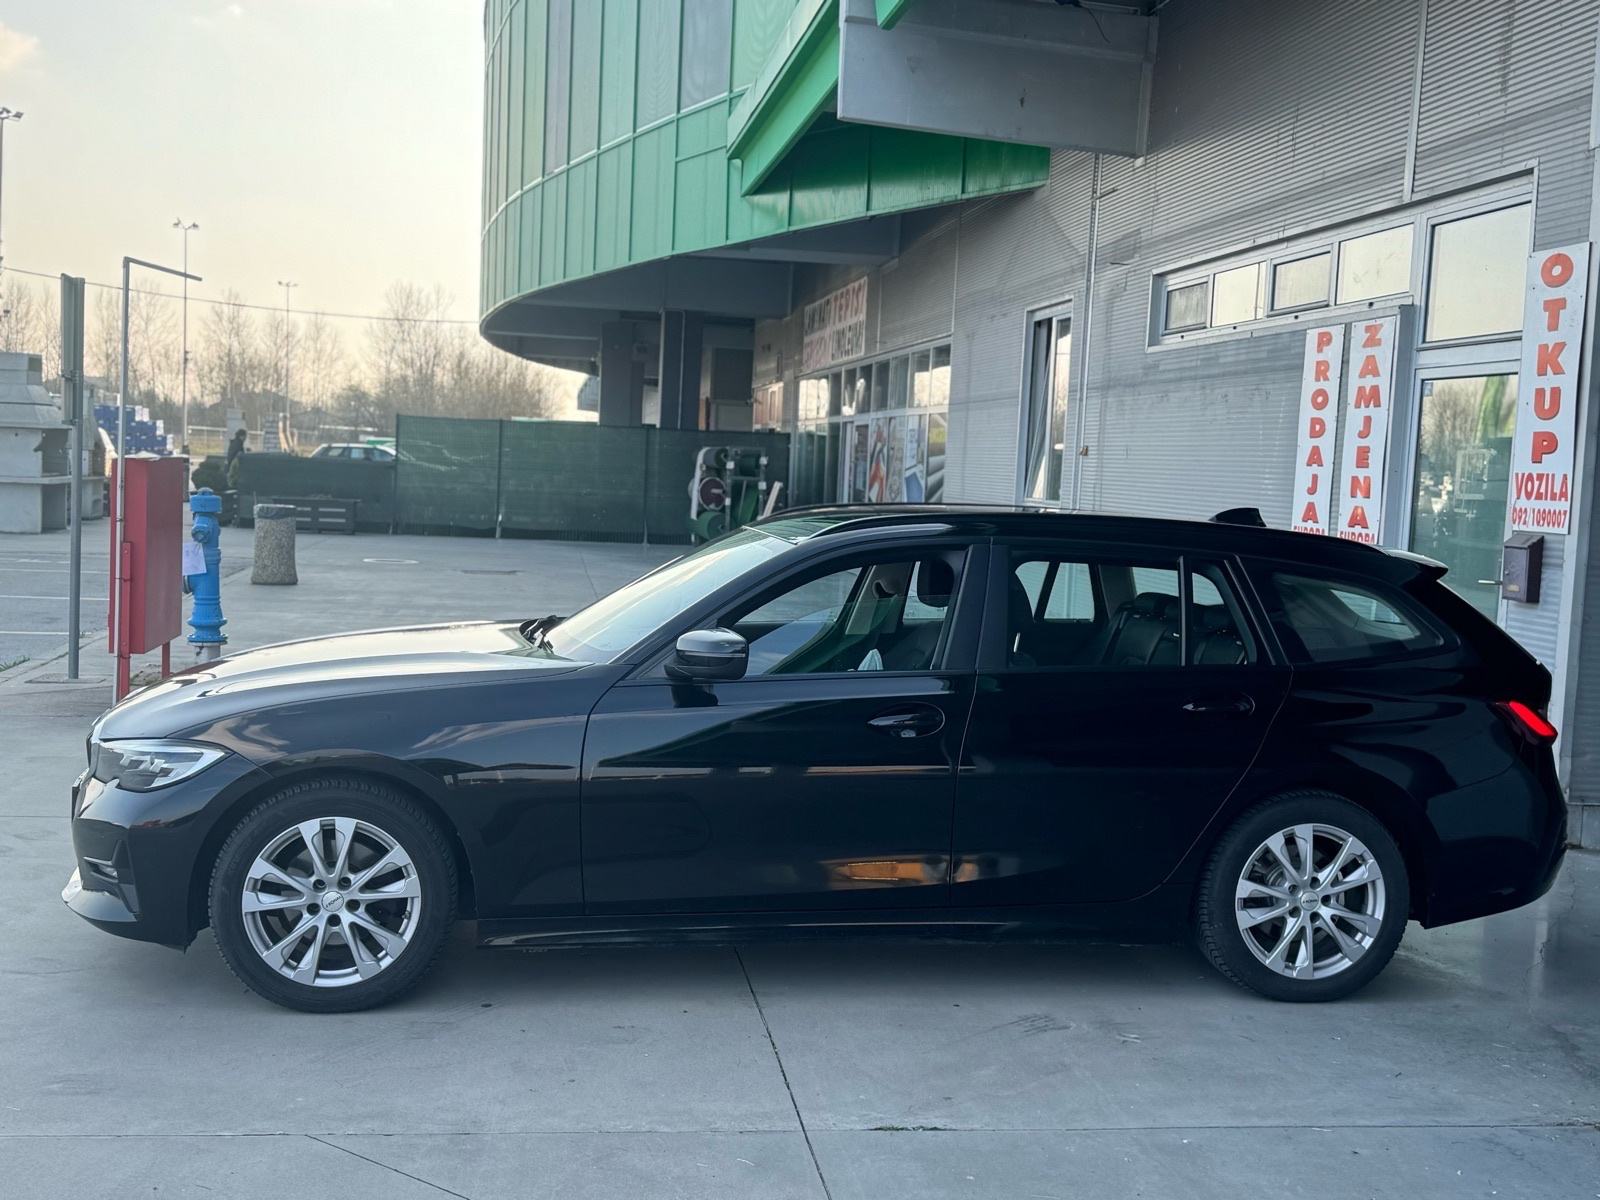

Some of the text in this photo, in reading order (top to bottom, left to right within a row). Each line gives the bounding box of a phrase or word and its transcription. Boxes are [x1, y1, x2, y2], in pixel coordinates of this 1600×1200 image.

[1302, 331, 1333, 523] PRODAJA
[1347, 324, 1384, 529] ZAMJENA
[1531, 253, 1574, 464] OTKUP
[1512, 507, 1568, 528] 092/1090007
[1515, 472, 1569, 502] VOZILA
